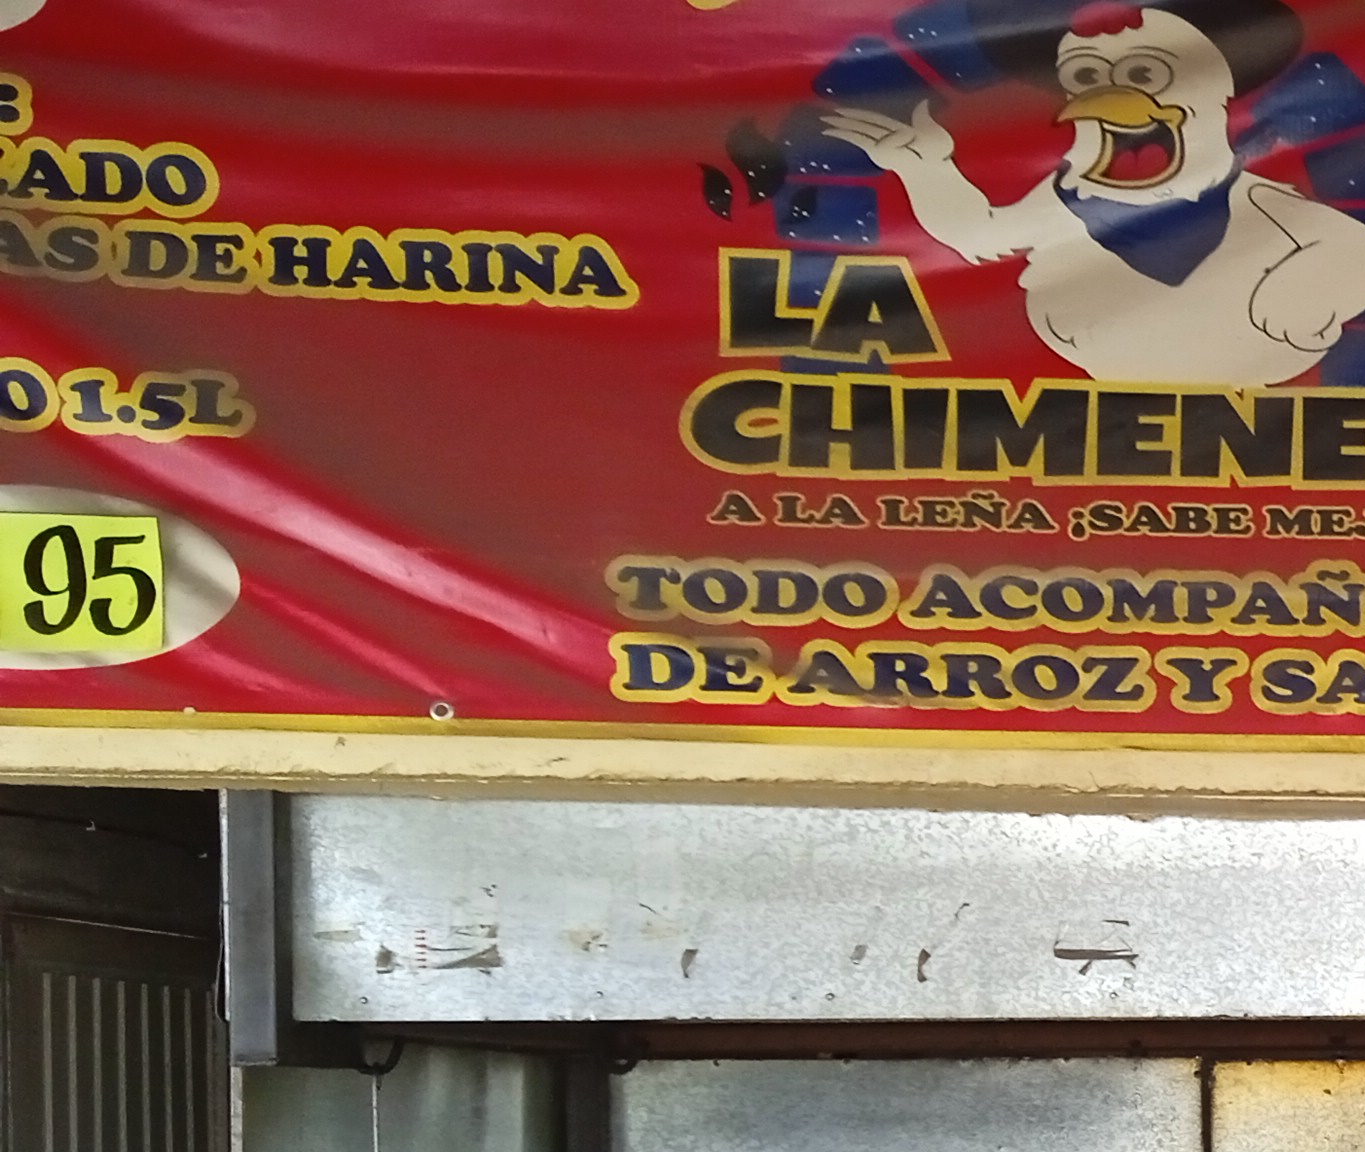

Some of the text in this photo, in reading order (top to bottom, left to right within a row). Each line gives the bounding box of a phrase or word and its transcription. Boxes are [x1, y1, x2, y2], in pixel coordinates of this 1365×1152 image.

[0, 148, 208, 207] ADO
[120, 230, 248, 284] DE
[267, 235, 627, 297] HARINA
[726, 254, 938, 356] LA
[69, 378, 244, 431] 1.5L
[711, 493, 763, 523] A
[776, 495, 865, 526] LA
[879, 492, 1056, 531] LEÑA
[1069, 502, 1253, 540] ¡SABE
[22, 524, 157, 637] 95
[616, 565, 888, 618] TODO
[623, 643, 764, 694] DE
[788, 649, 1146, 702] ARROZ
[1165, 656, 1237, 703] Y
